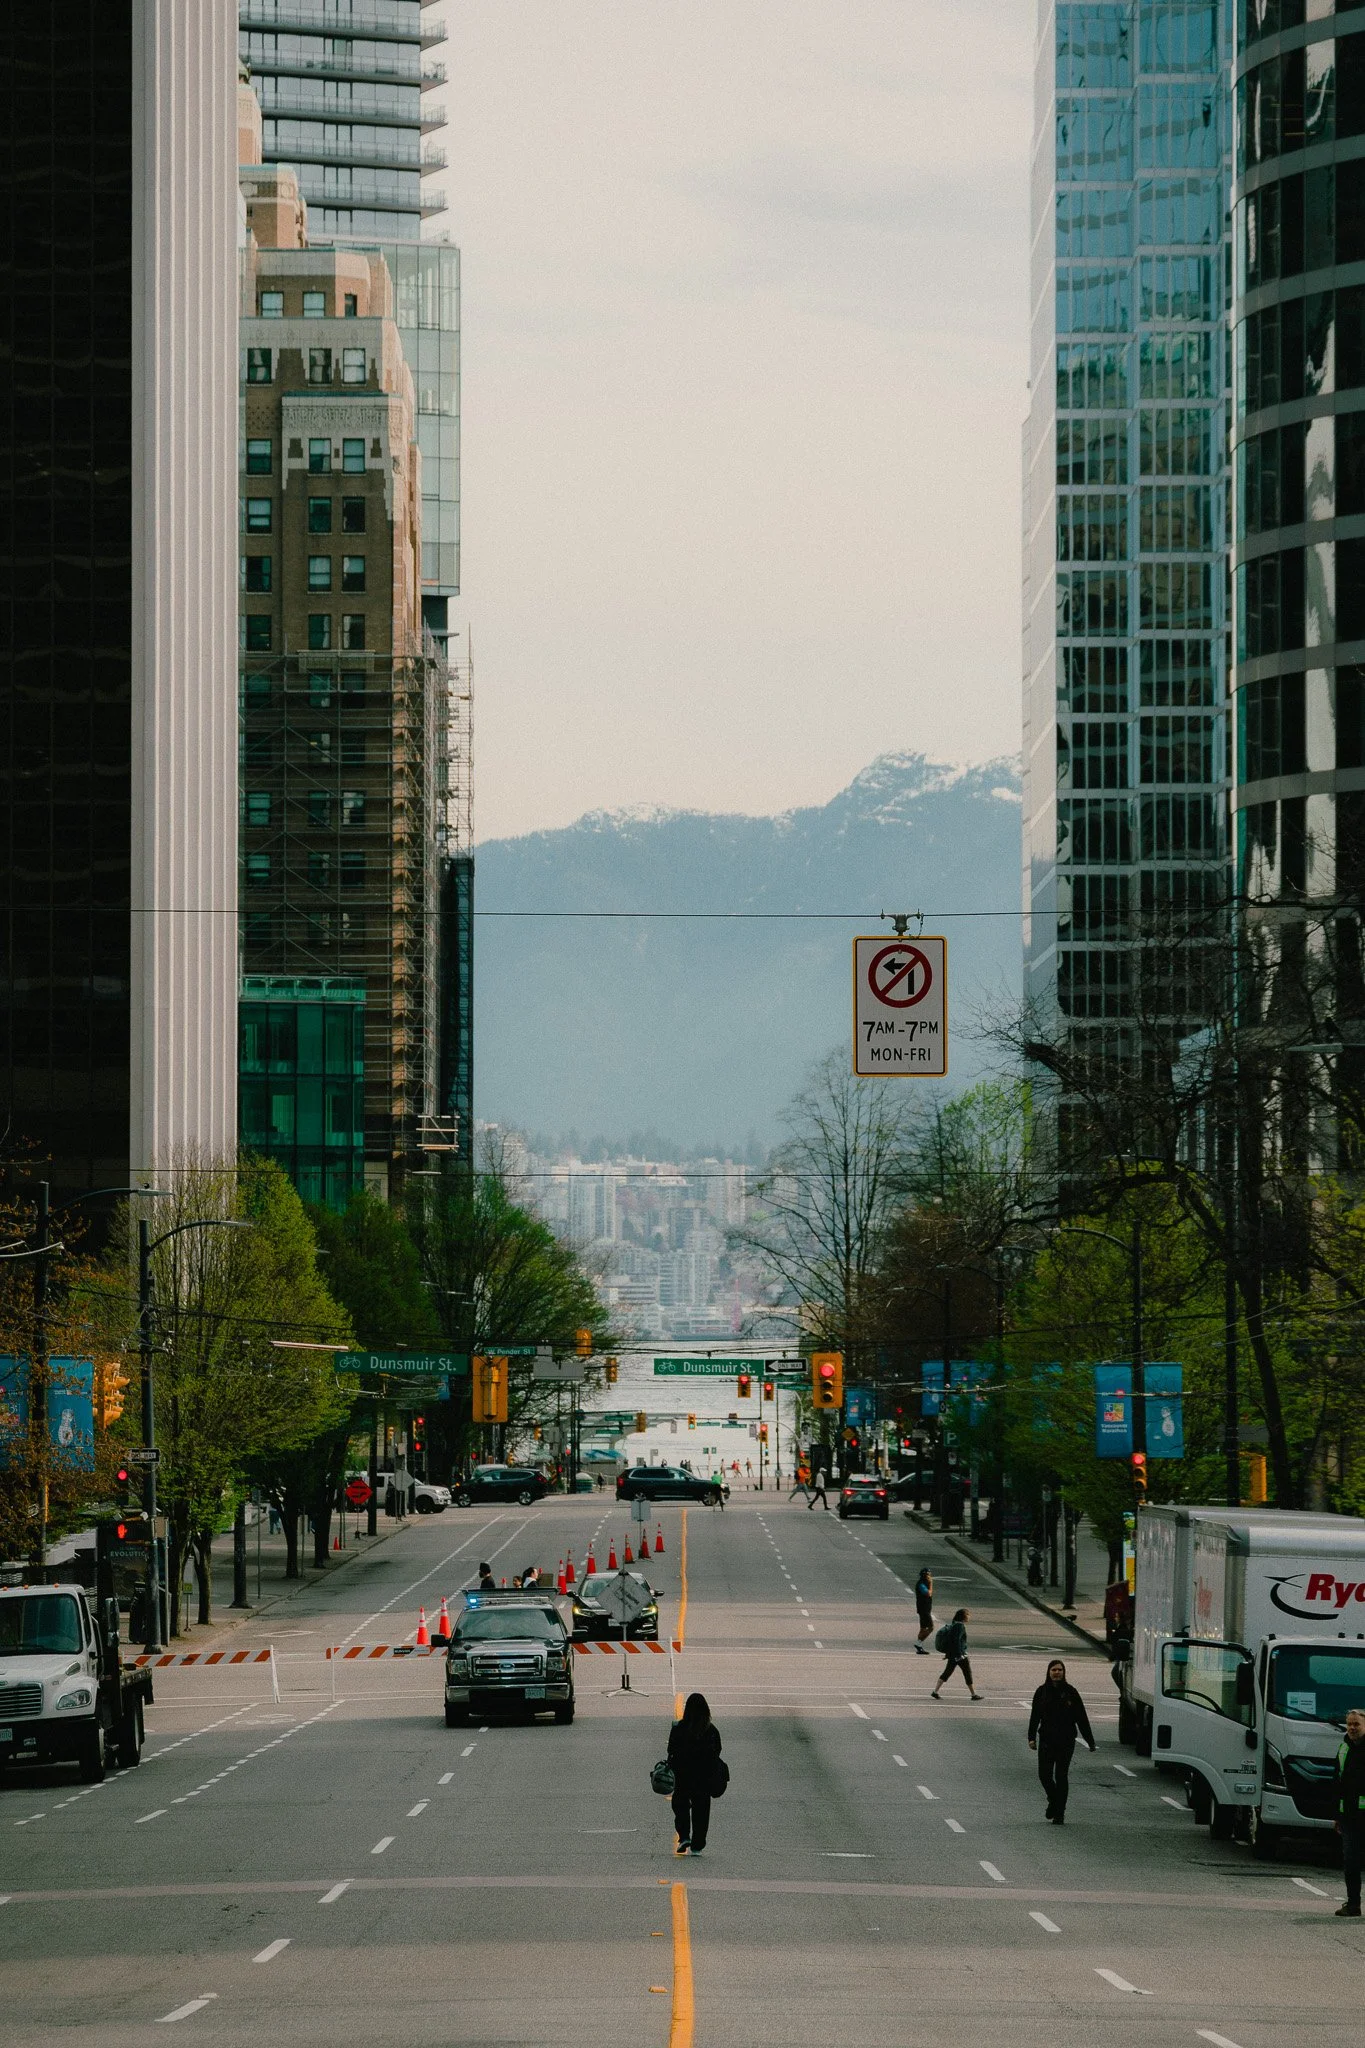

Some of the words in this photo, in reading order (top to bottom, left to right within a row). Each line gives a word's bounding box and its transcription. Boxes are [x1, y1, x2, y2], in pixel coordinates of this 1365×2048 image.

[870, 1048, 931, 1061] MON-FRI
[370, 1356, 436, 1371] Dunsmuir
[438, 1358, 457, 1372] St.
[683, 1361, 738, 1373] Dunsmuir
[739, 1362, 756, 1374] St.
[947, 1432, 957, 1445] P
